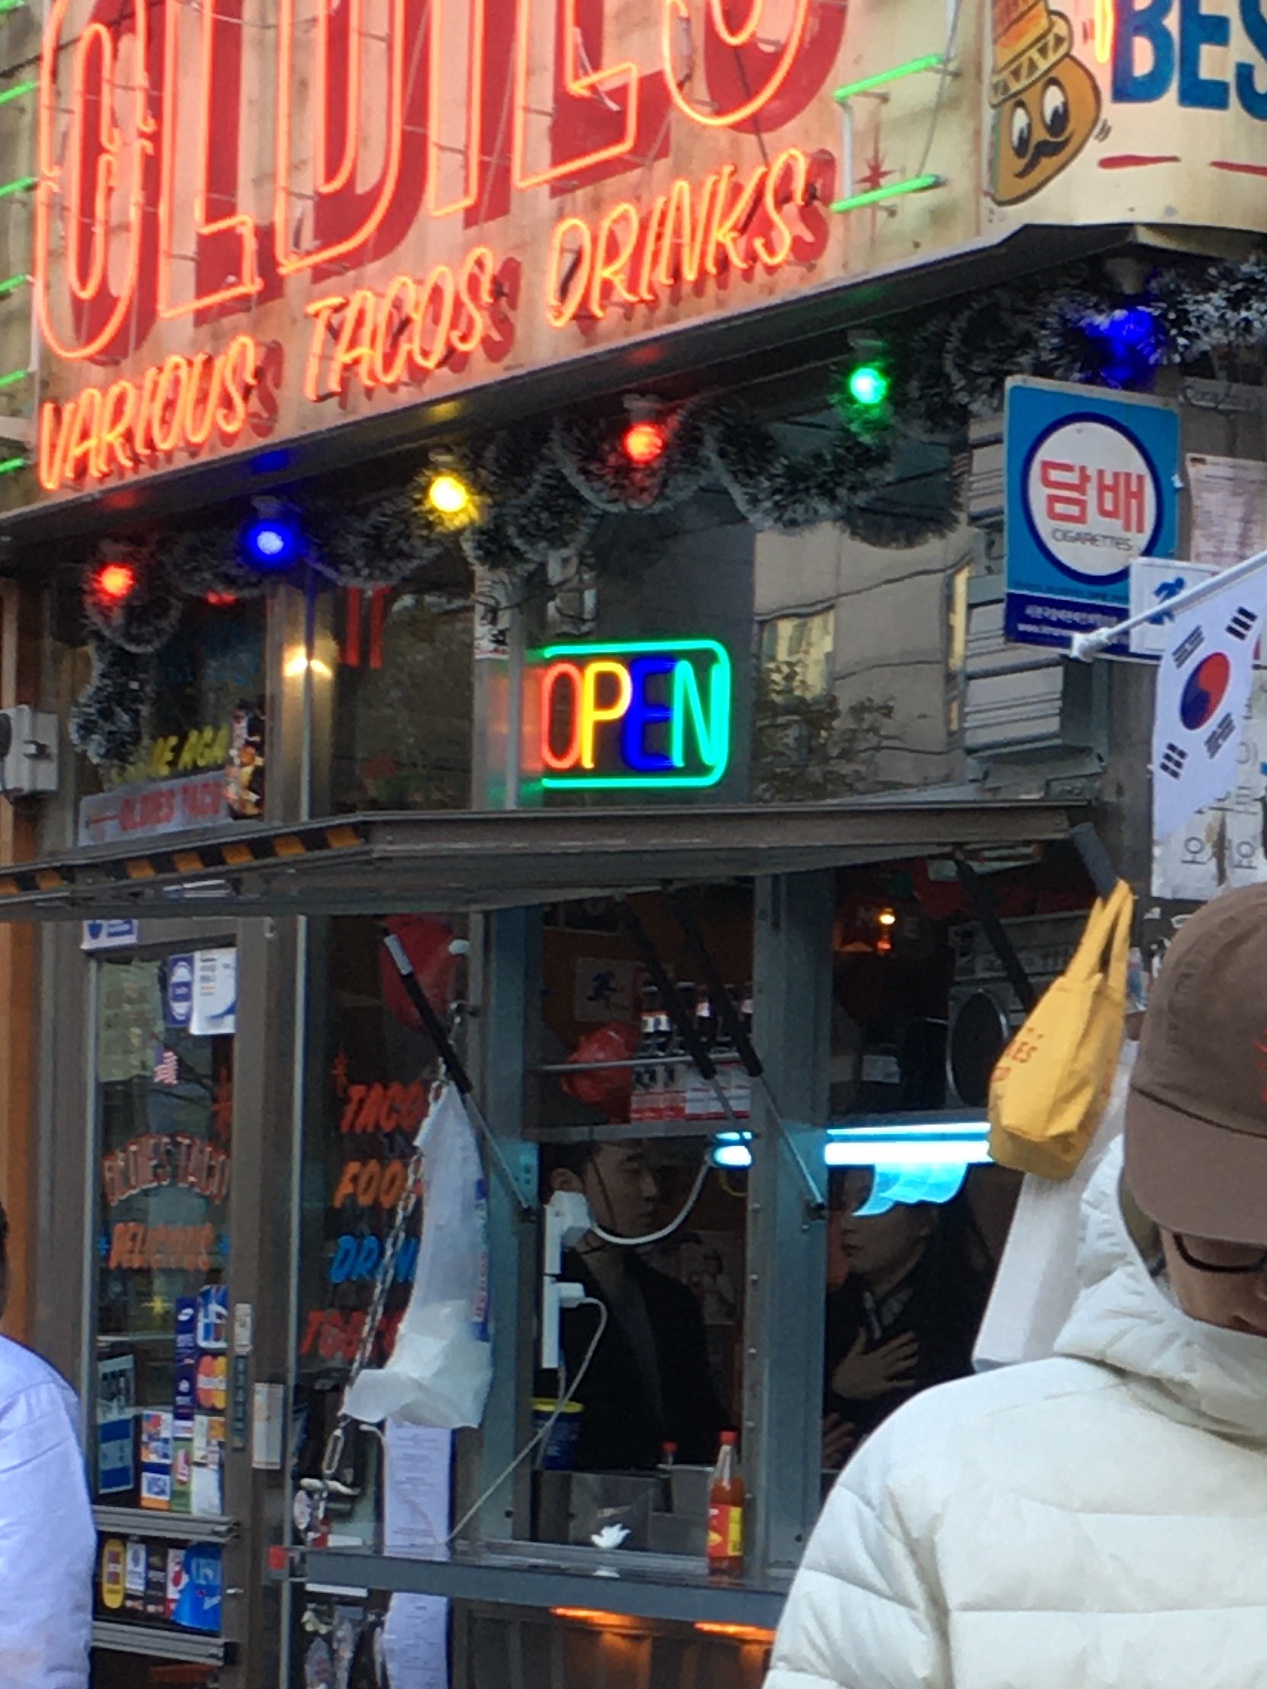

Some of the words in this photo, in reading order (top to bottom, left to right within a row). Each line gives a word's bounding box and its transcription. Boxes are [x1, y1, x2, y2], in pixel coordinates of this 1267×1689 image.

[37, 334, 262, 491] VARIOUS
[303, 246, 505, 403] TACOS
[546, 148, 820, 329] DRINKS
[1041, 459, 1146, 535] 담배
[1051, 527, 1133, 552] CIGARETTES
[540, 656, 727, 771] OPEN
[340, 1080, 430, 1134] TACO
[333, 1158, 424, 1209] FOO
